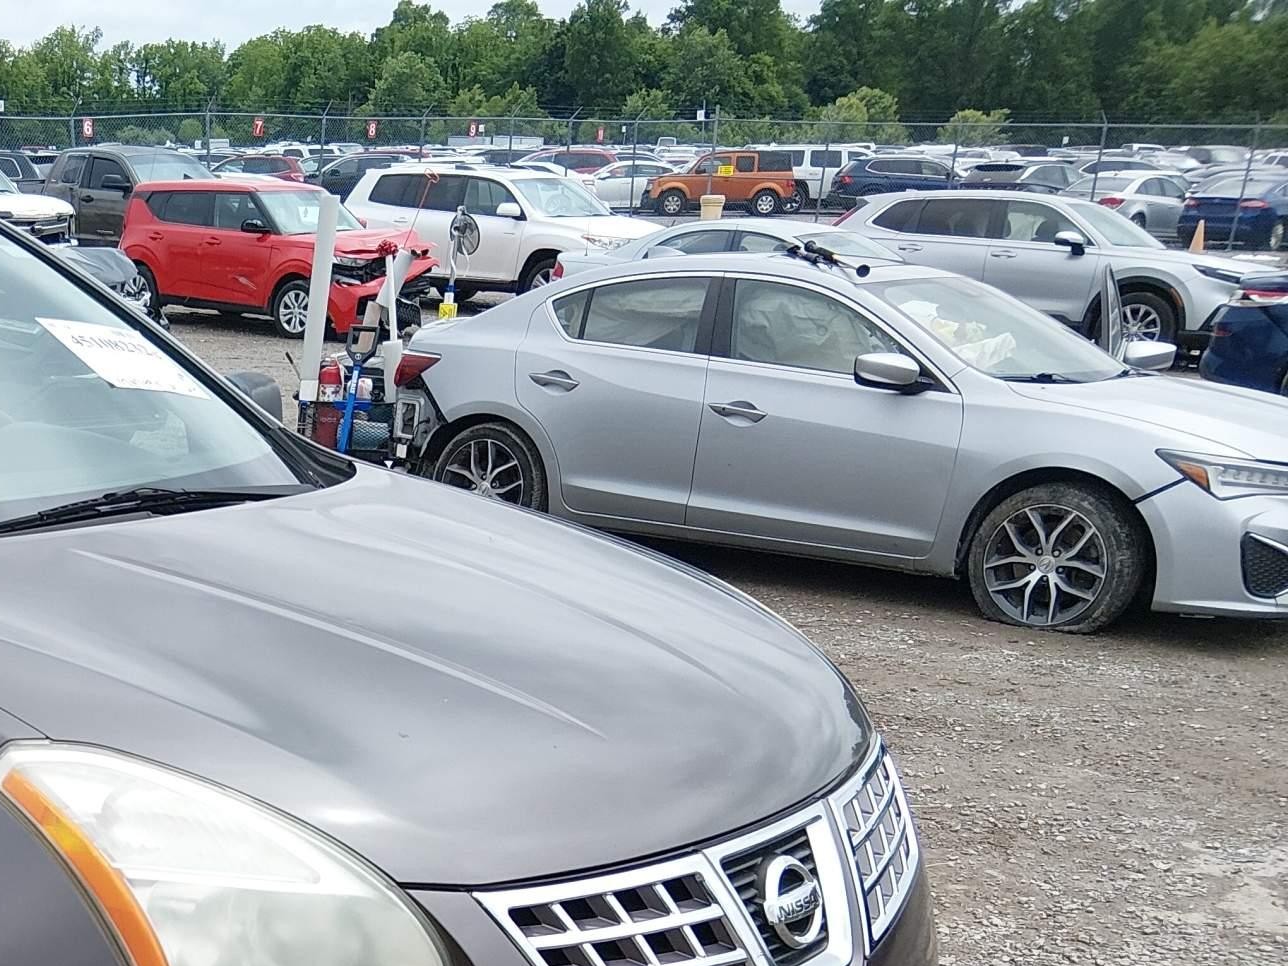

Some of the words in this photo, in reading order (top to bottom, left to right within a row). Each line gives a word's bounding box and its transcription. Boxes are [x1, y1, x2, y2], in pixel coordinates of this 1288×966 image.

[83, 120, 93, 134] 6
[254, 120, 263, 134] 7
[368, 122, 377, 136] 8
[469, 124, 476, 137] 9
